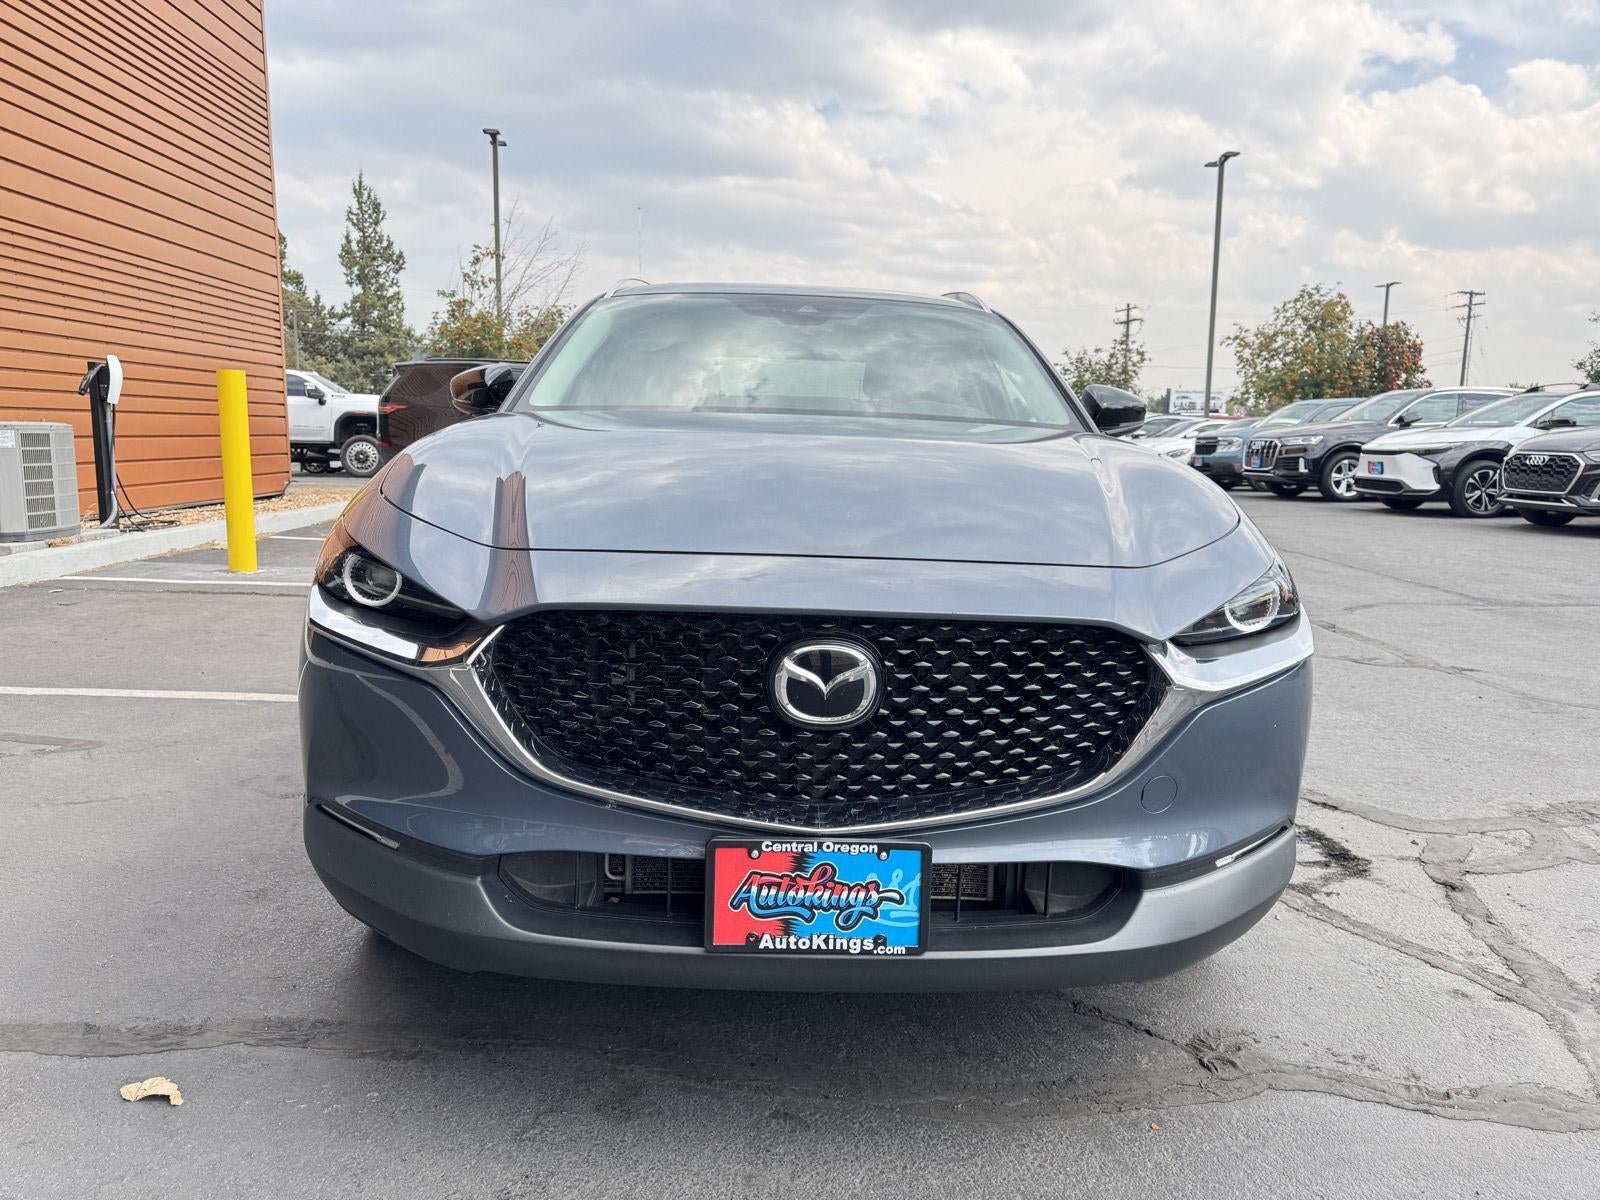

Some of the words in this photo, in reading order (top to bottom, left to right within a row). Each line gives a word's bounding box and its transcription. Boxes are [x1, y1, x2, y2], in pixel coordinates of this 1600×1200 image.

[761, 841, 817, 853] Central
[822, 842, 878, 855] Oregon
[759, 934, 906, 955] AutoKings.com
